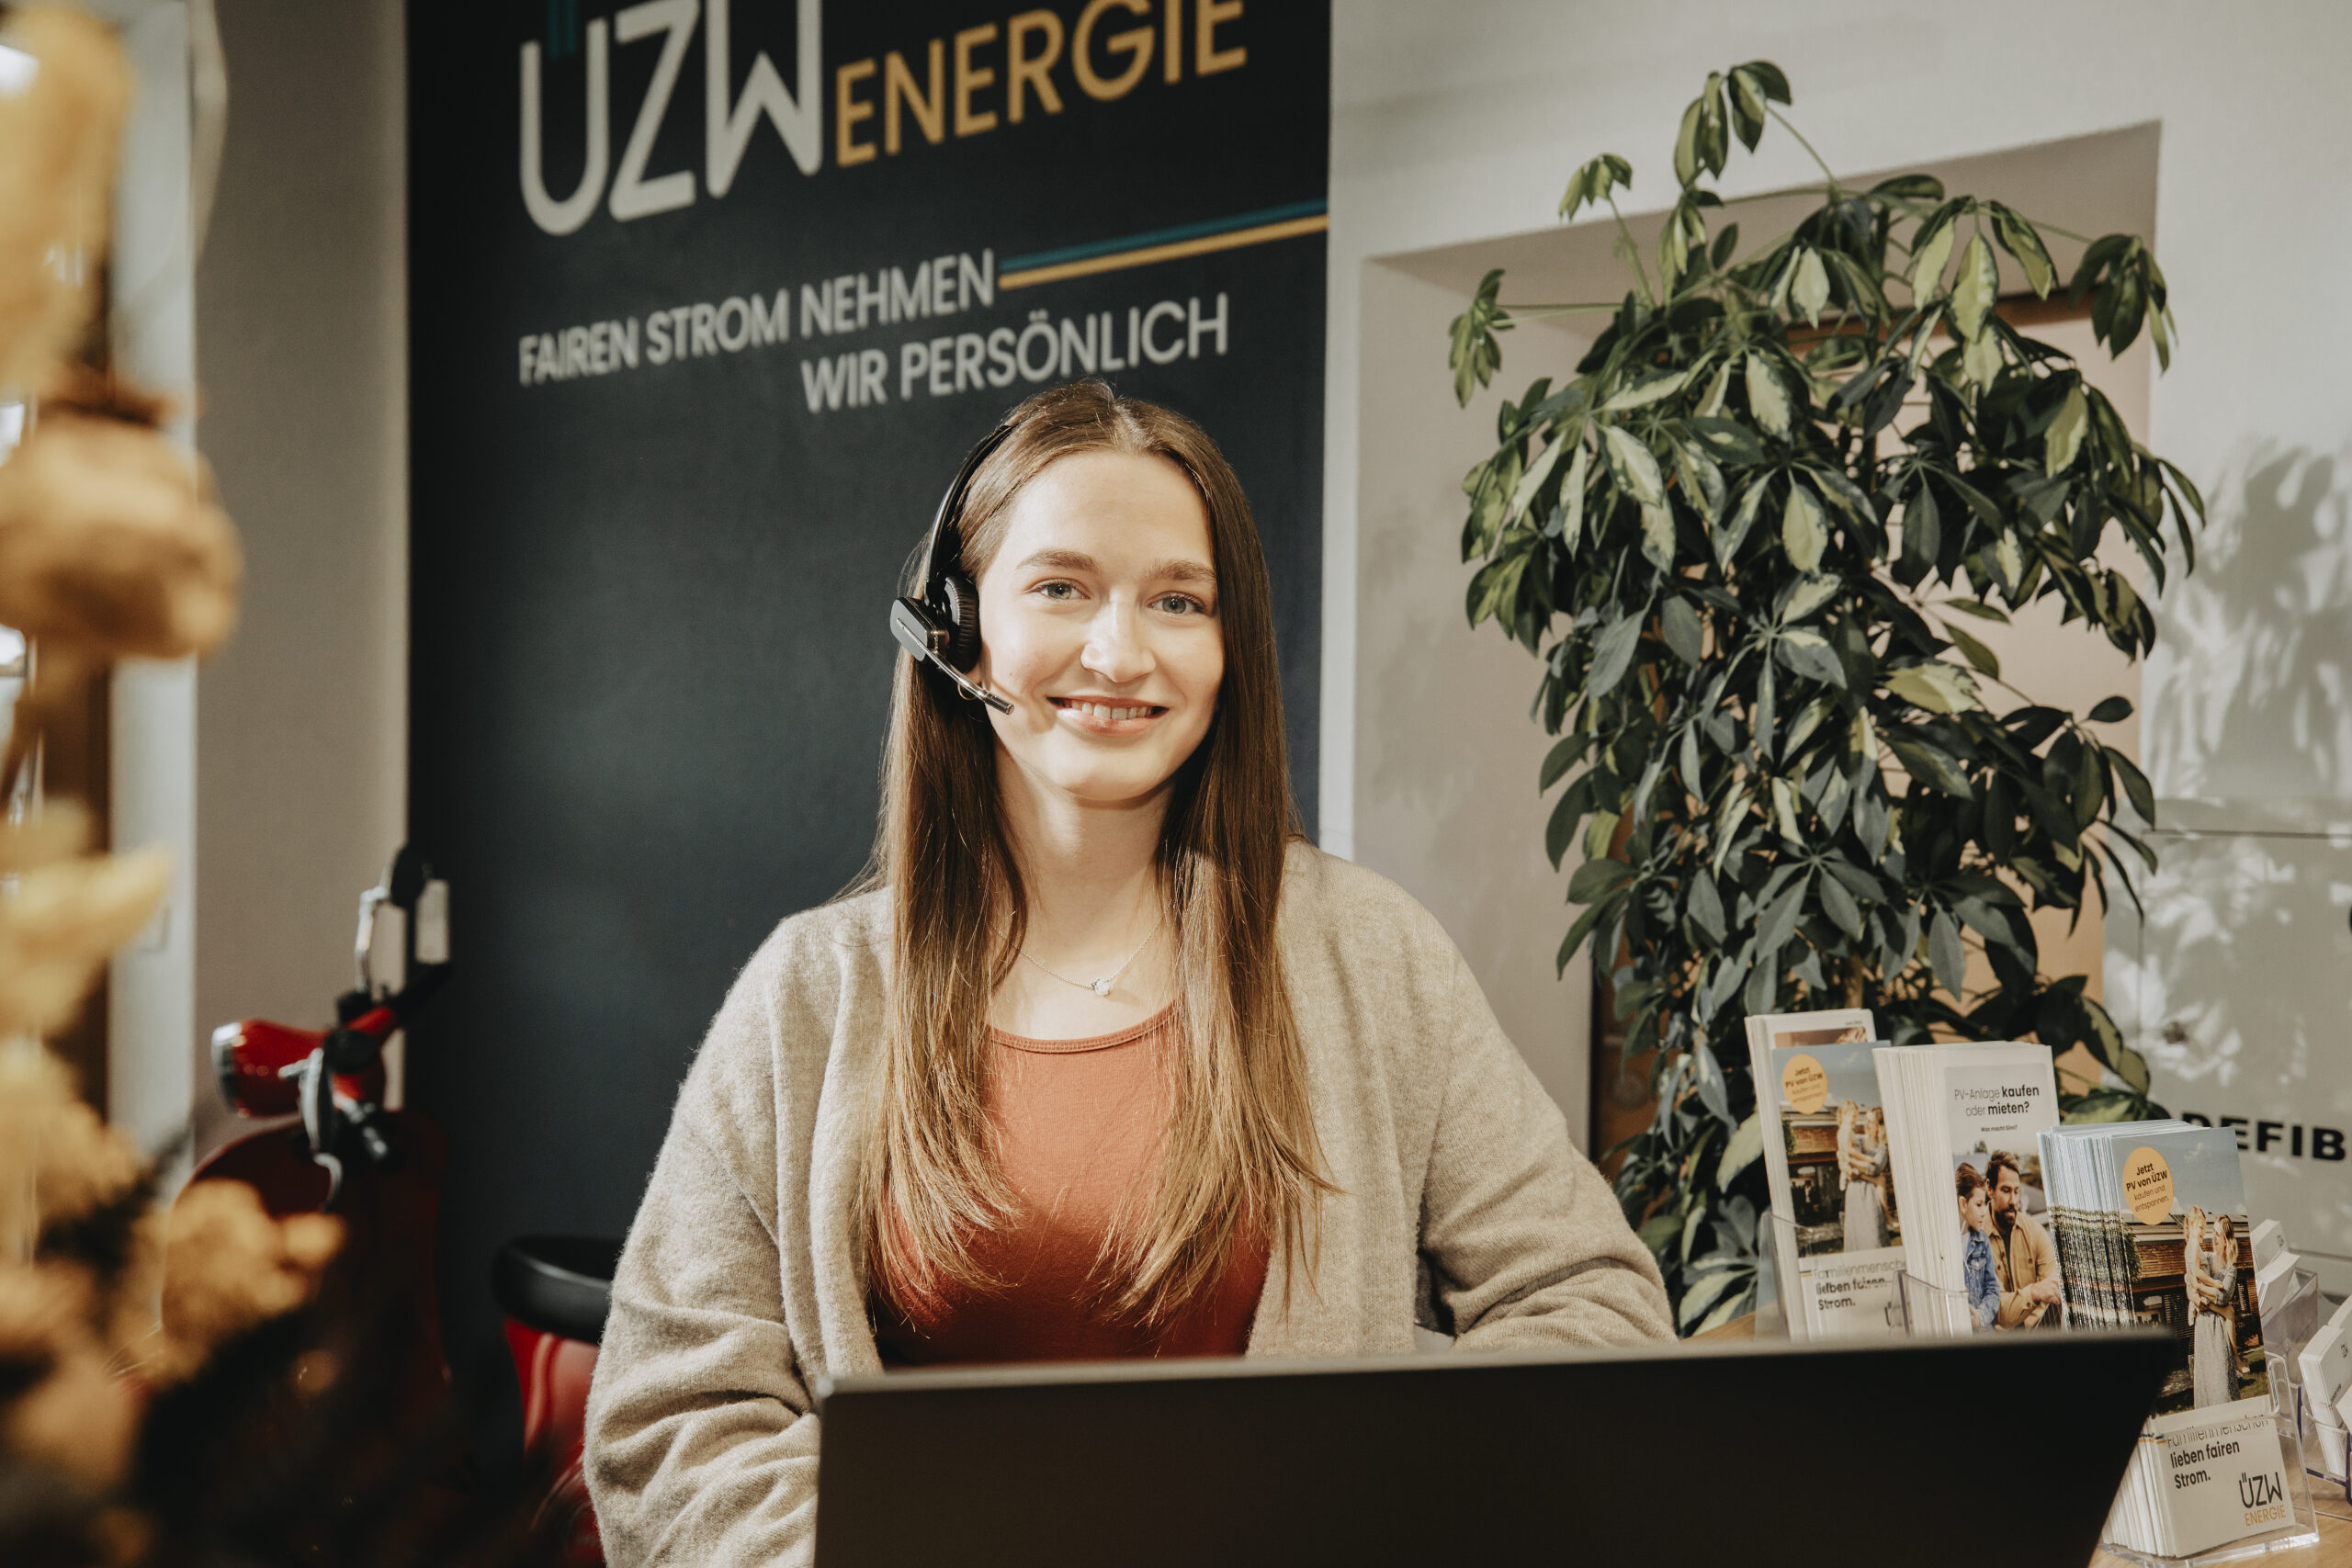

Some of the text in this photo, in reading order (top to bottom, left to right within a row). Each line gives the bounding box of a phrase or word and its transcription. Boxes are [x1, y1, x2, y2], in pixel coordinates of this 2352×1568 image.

[519, 0, 1248, 236] ÜZW ENERGIE
[518, 247, 995, 388] FAIREN STROM NEHMEN
[801, 291, 1228, 413] WIR PERSÖNLICH
[1954, 1084, 2040, 1101] PV-Anlage kaufen
[1966, 1101, 2030, 1117] oder mieten?
[2126, 1169, 2168, 1192] PV von ÜZW
[2136, 1163, 2154, 1176] Jetzt
[2133, 1184, 2165, 1201] kaufen und
[2170, 1440, 2240, 1469] lieben fairen
[2174, 1470, 2211, 1489] Strom.
[2239, 1472, 2283, 1508] ÜZW
[2245, 1505, 2287, 1526] ENERGIE
